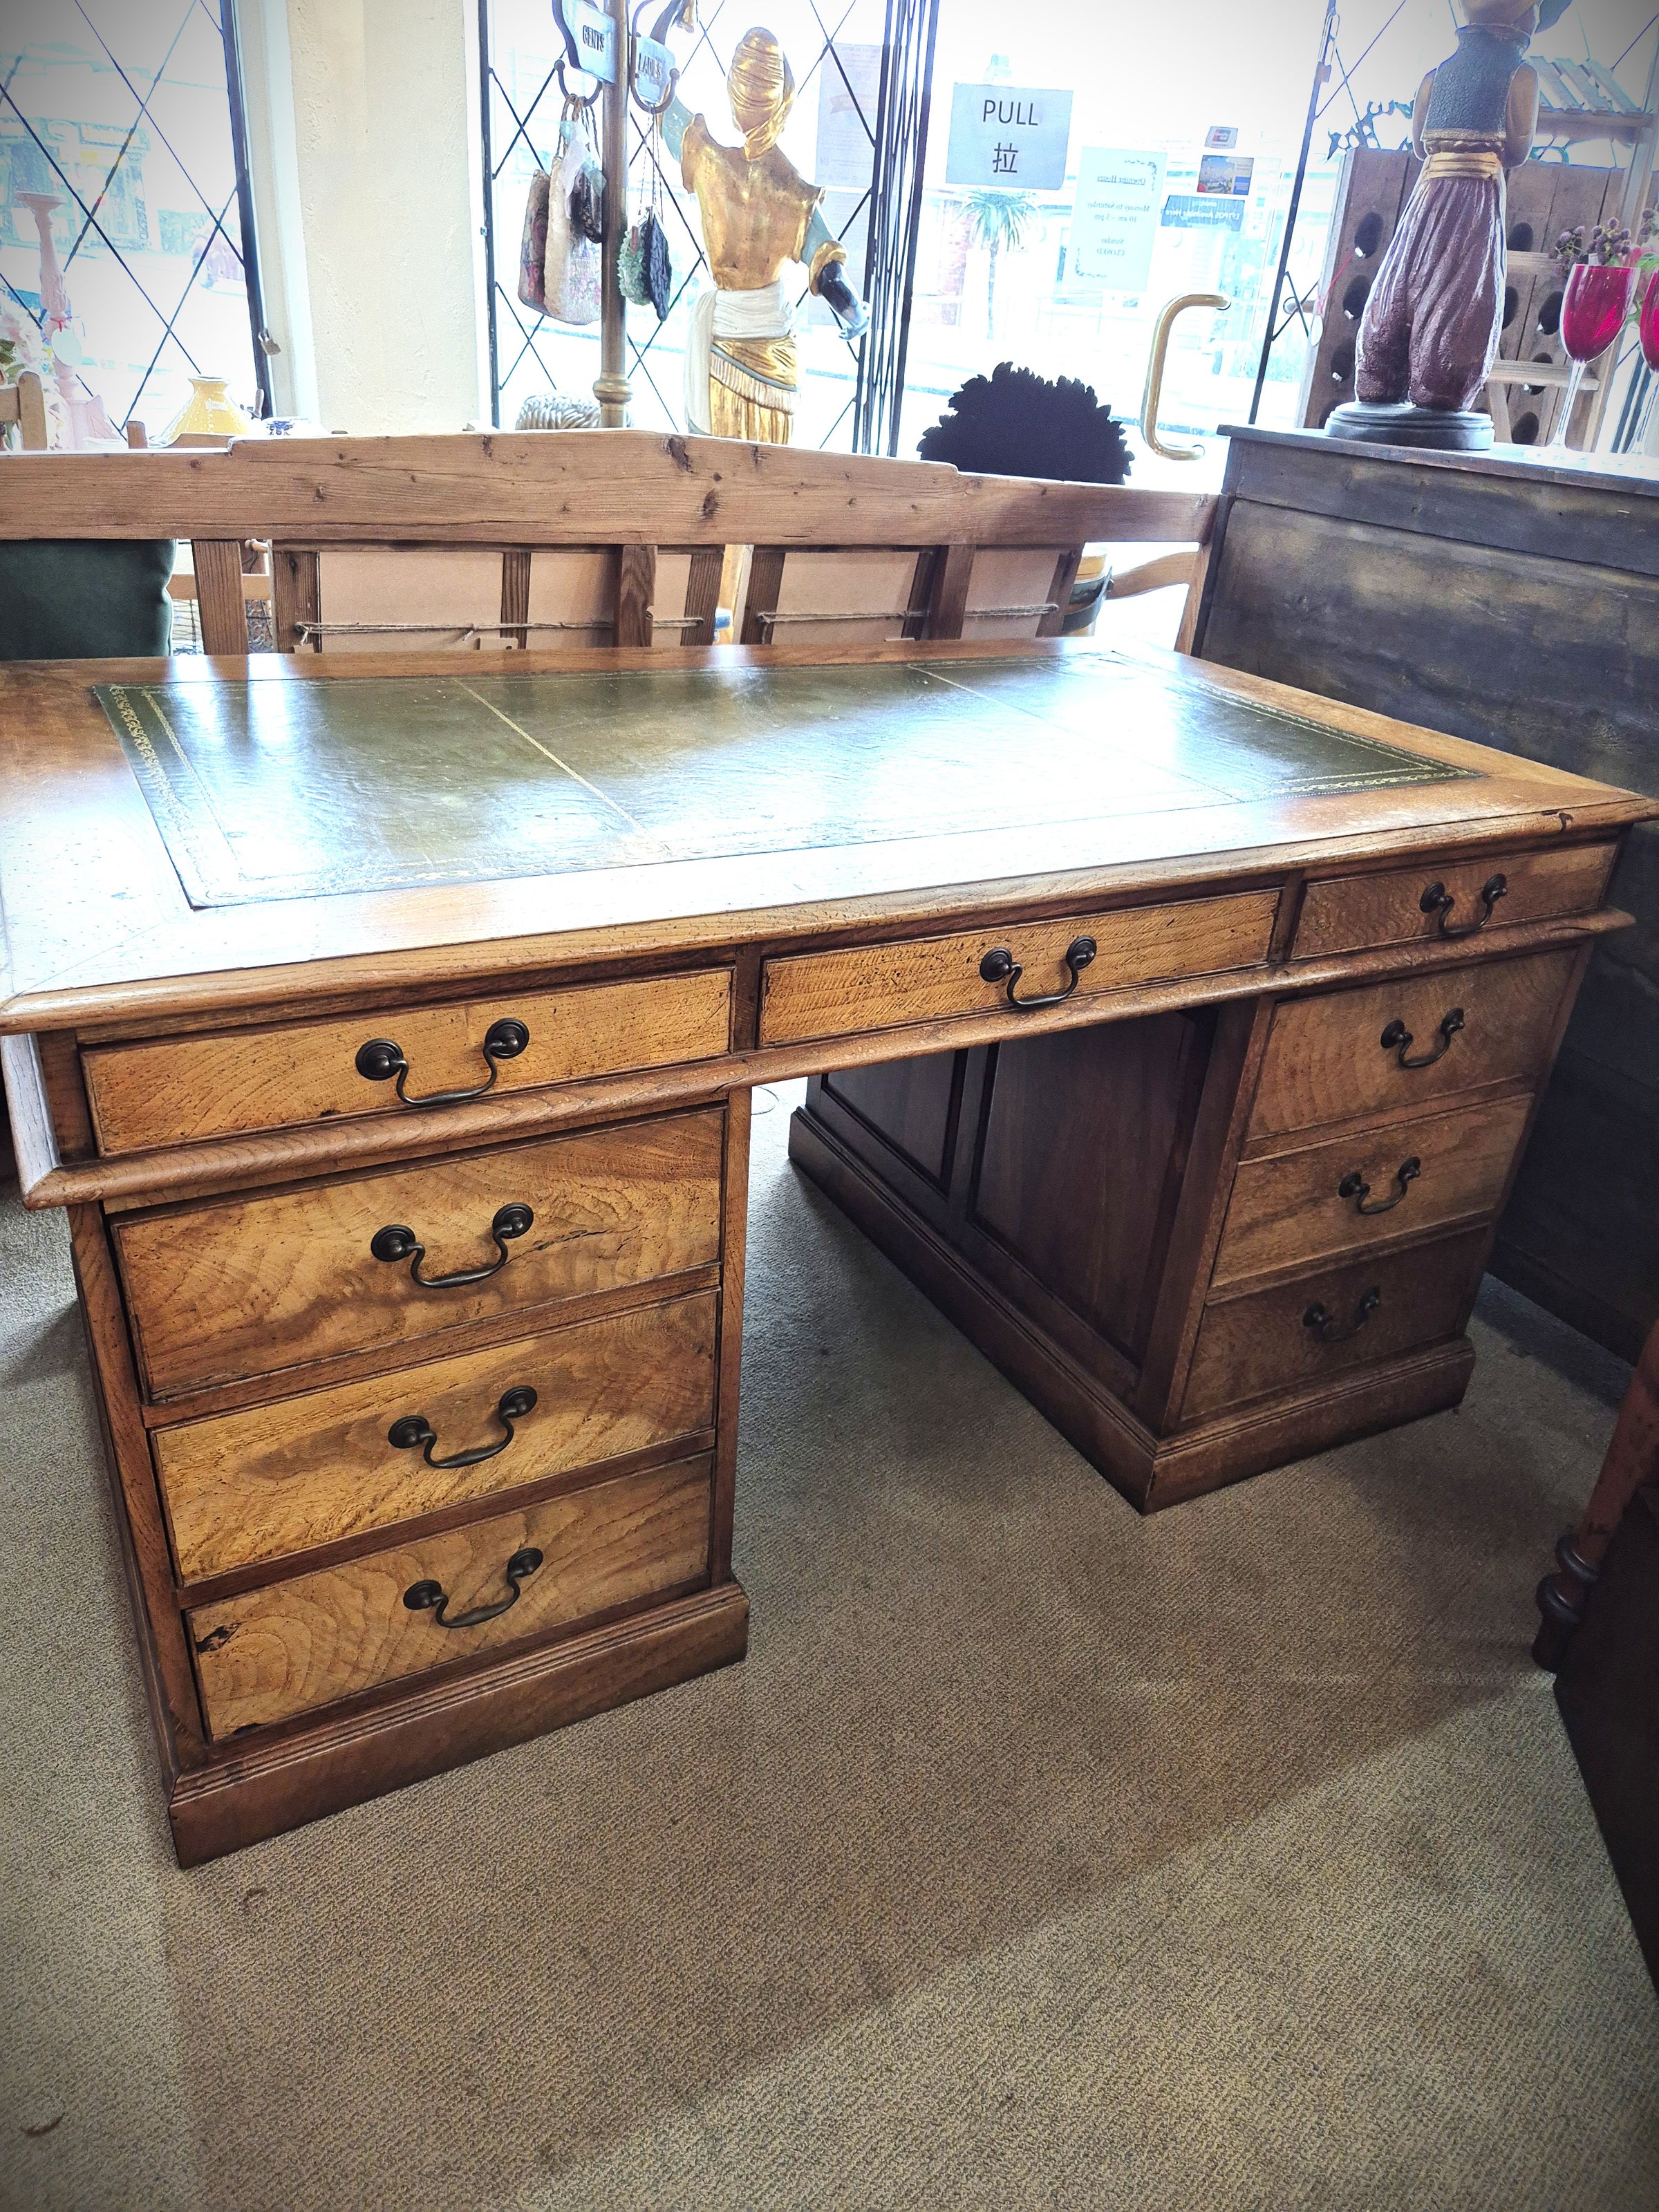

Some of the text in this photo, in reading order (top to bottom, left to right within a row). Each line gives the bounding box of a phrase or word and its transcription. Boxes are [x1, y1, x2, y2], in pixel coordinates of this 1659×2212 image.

[582, 25, 605, 53] GENTS
[638, 53, 662, 79] LADIES
[982, 100, 1038, 126] PULL
[993, 142, 1019, 173] 拉
